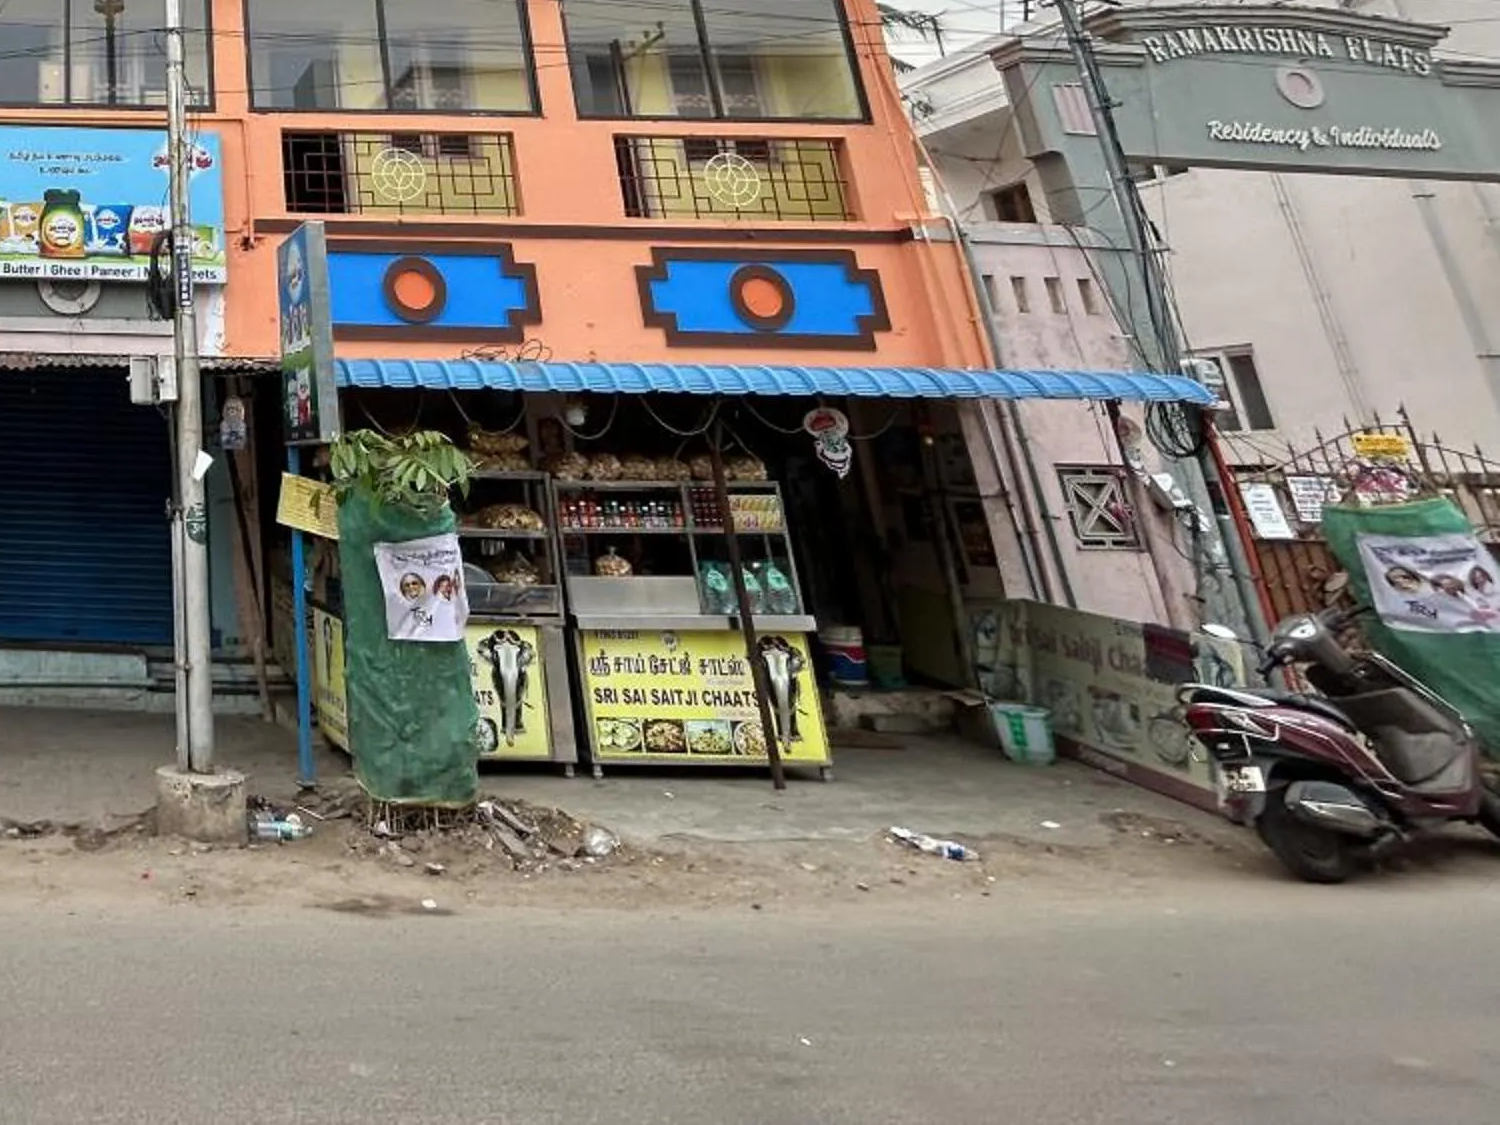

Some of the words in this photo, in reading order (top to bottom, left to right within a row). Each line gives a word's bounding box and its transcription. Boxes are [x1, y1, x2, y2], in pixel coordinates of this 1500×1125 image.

[1143, 26, 1333, 63] RAMAKRISHNA
[1345, 36, 1430, 75] FLATS
[1207, 120, 1311, 151] Residency
[1329, 125, 1442, 150] Individuals
[3, 262, 41, 275] Butter
[51, 263, 82, 276] Ghee
[91, 264, 134, 277] Paneer
[593, 687, 618, 704] SRI
[622, 688, 647, 704] SAI
[701, 689, 760, 707] CHAATS
